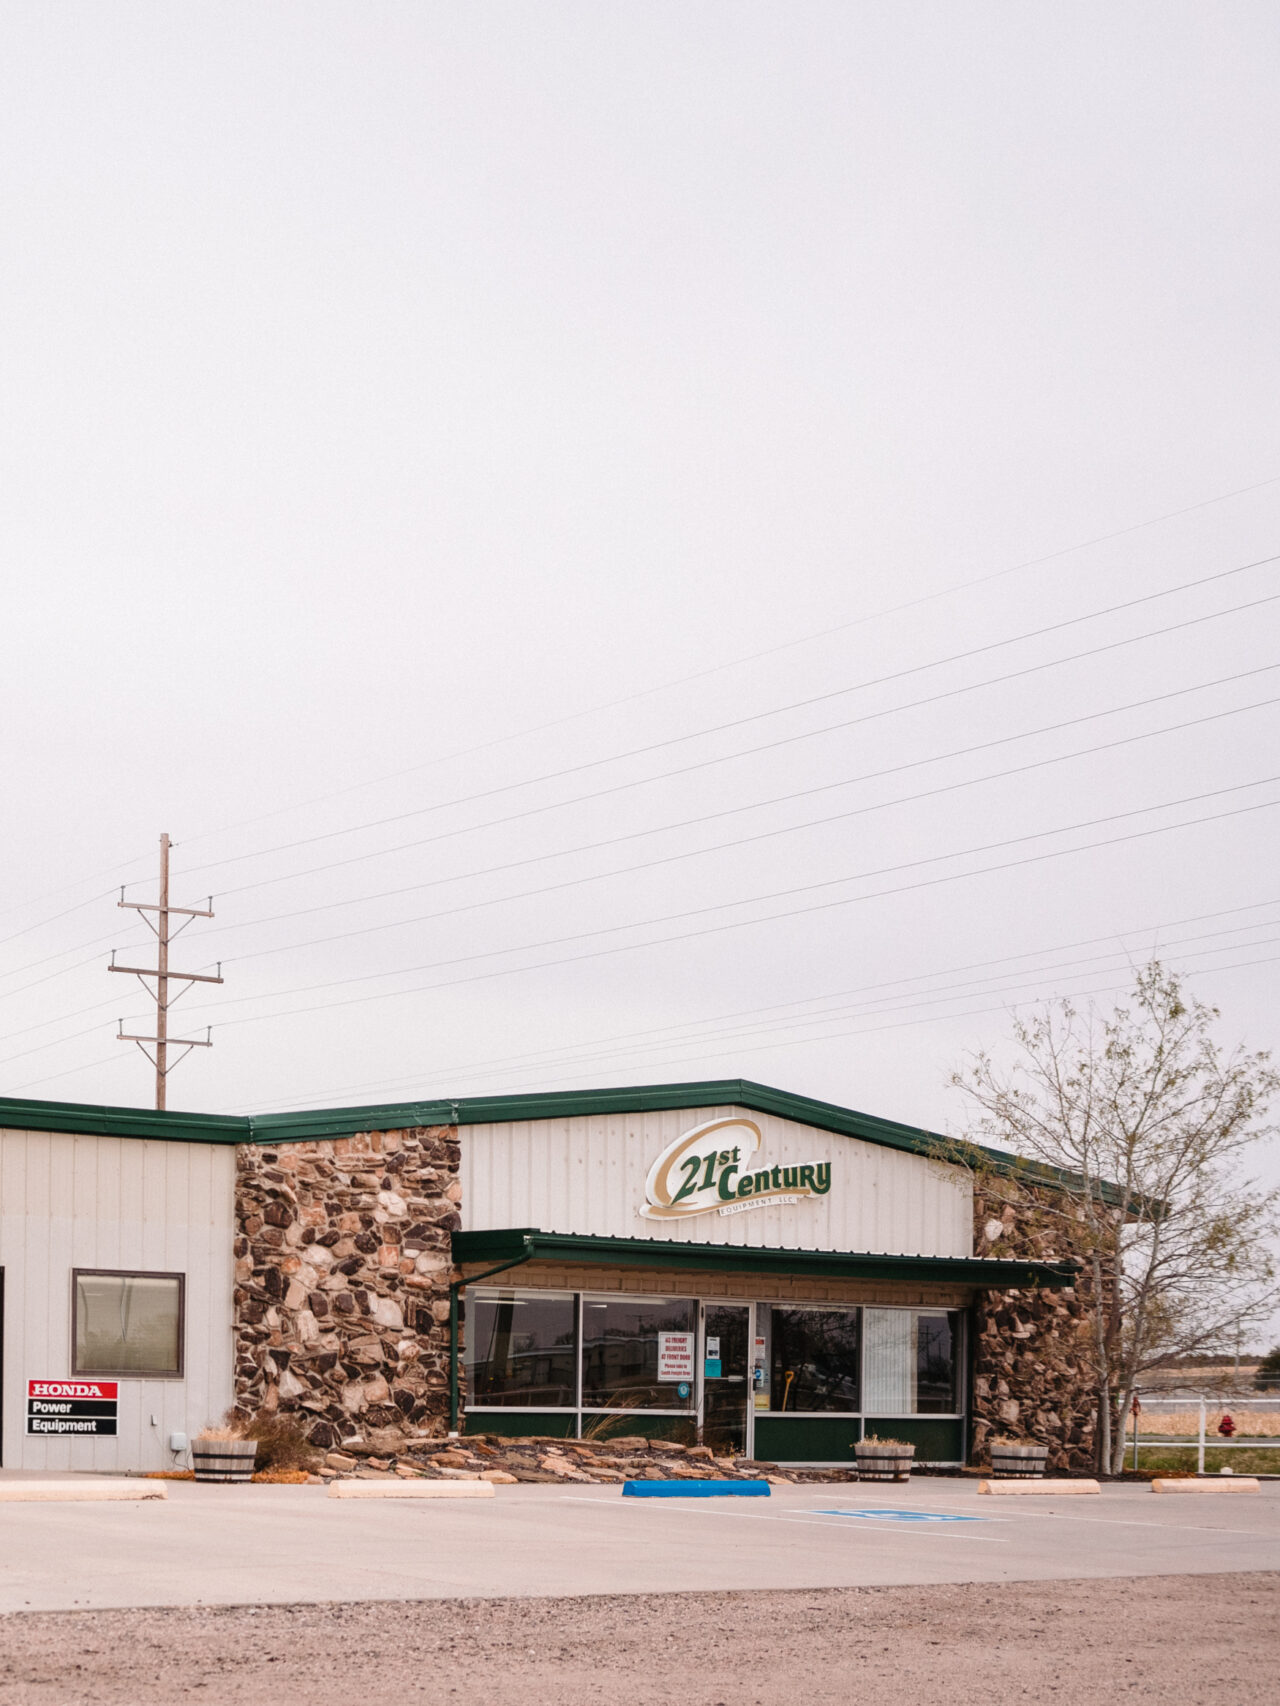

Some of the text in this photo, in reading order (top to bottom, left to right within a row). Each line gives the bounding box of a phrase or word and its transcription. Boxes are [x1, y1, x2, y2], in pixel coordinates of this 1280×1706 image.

[671, 1146, 741, 1205] 21st
[720, 1196, 794, 1216] EQUIPMENT LLC
[32, 1384, 103, 1397] HONDA
[32, 1401, 73, 1413] Power
[32, 1419, 97, 1433] Equipment
